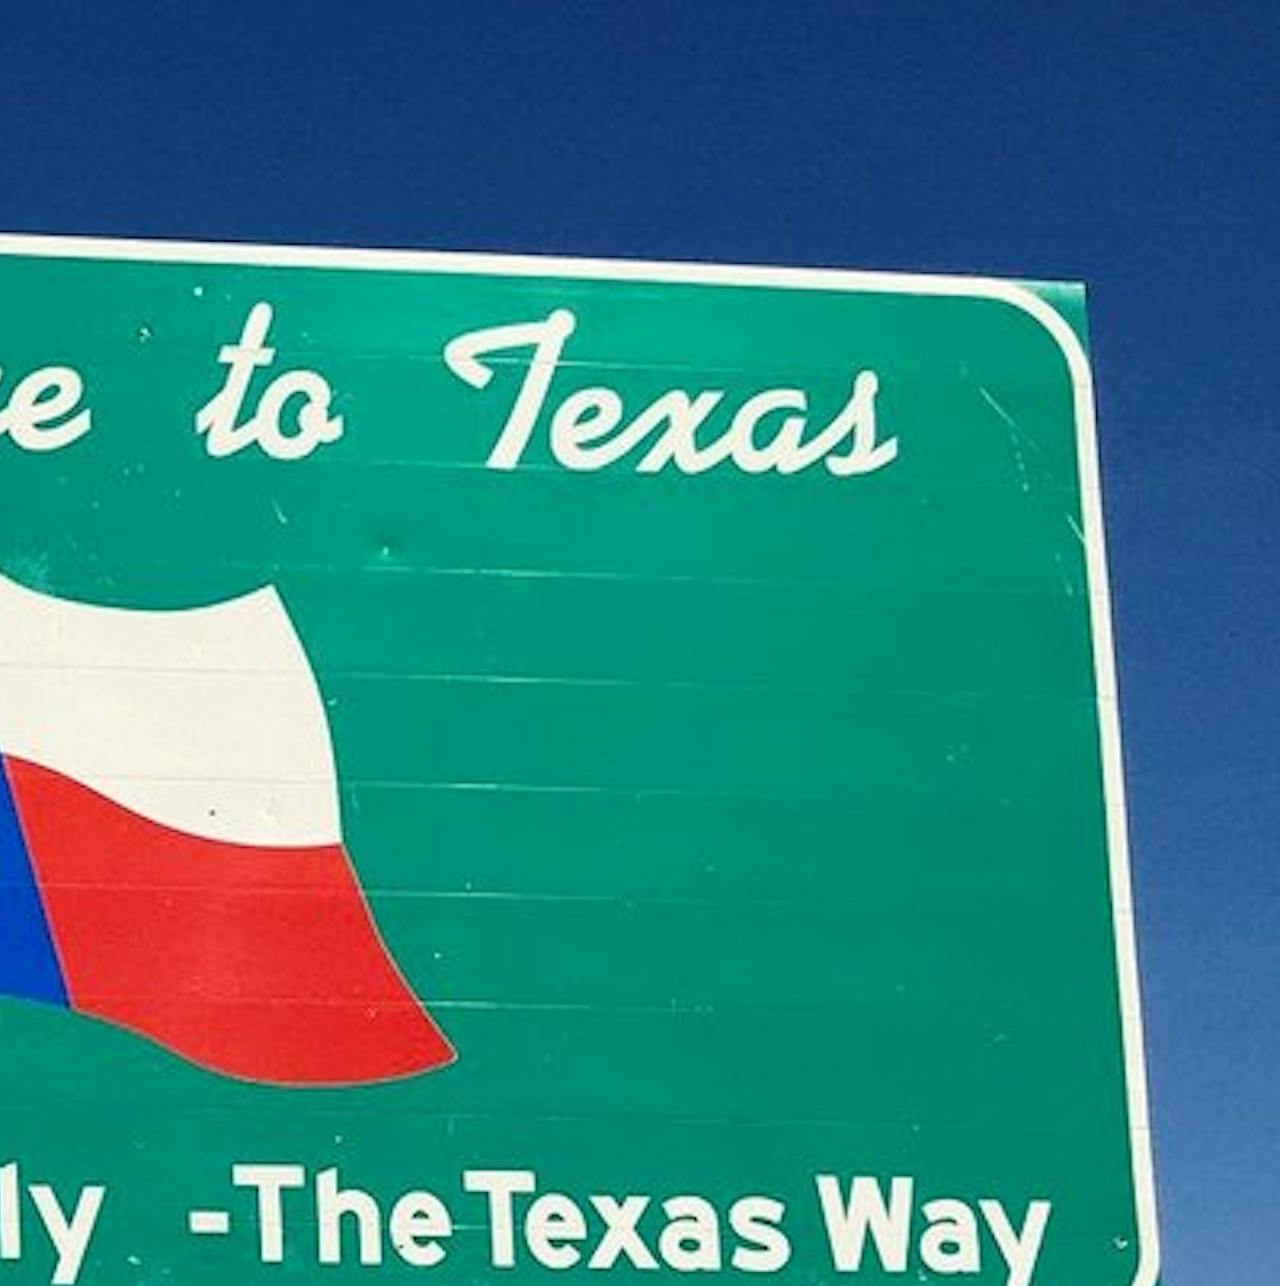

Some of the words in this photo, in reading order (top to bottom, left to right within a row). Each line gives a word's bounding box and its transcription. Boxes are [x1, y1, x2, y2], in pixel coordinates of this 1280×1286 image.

[196, 302, 344, 460] to
[444, 308, 898, 476] Texas
[463, 1169, 791, 1273] Texas
